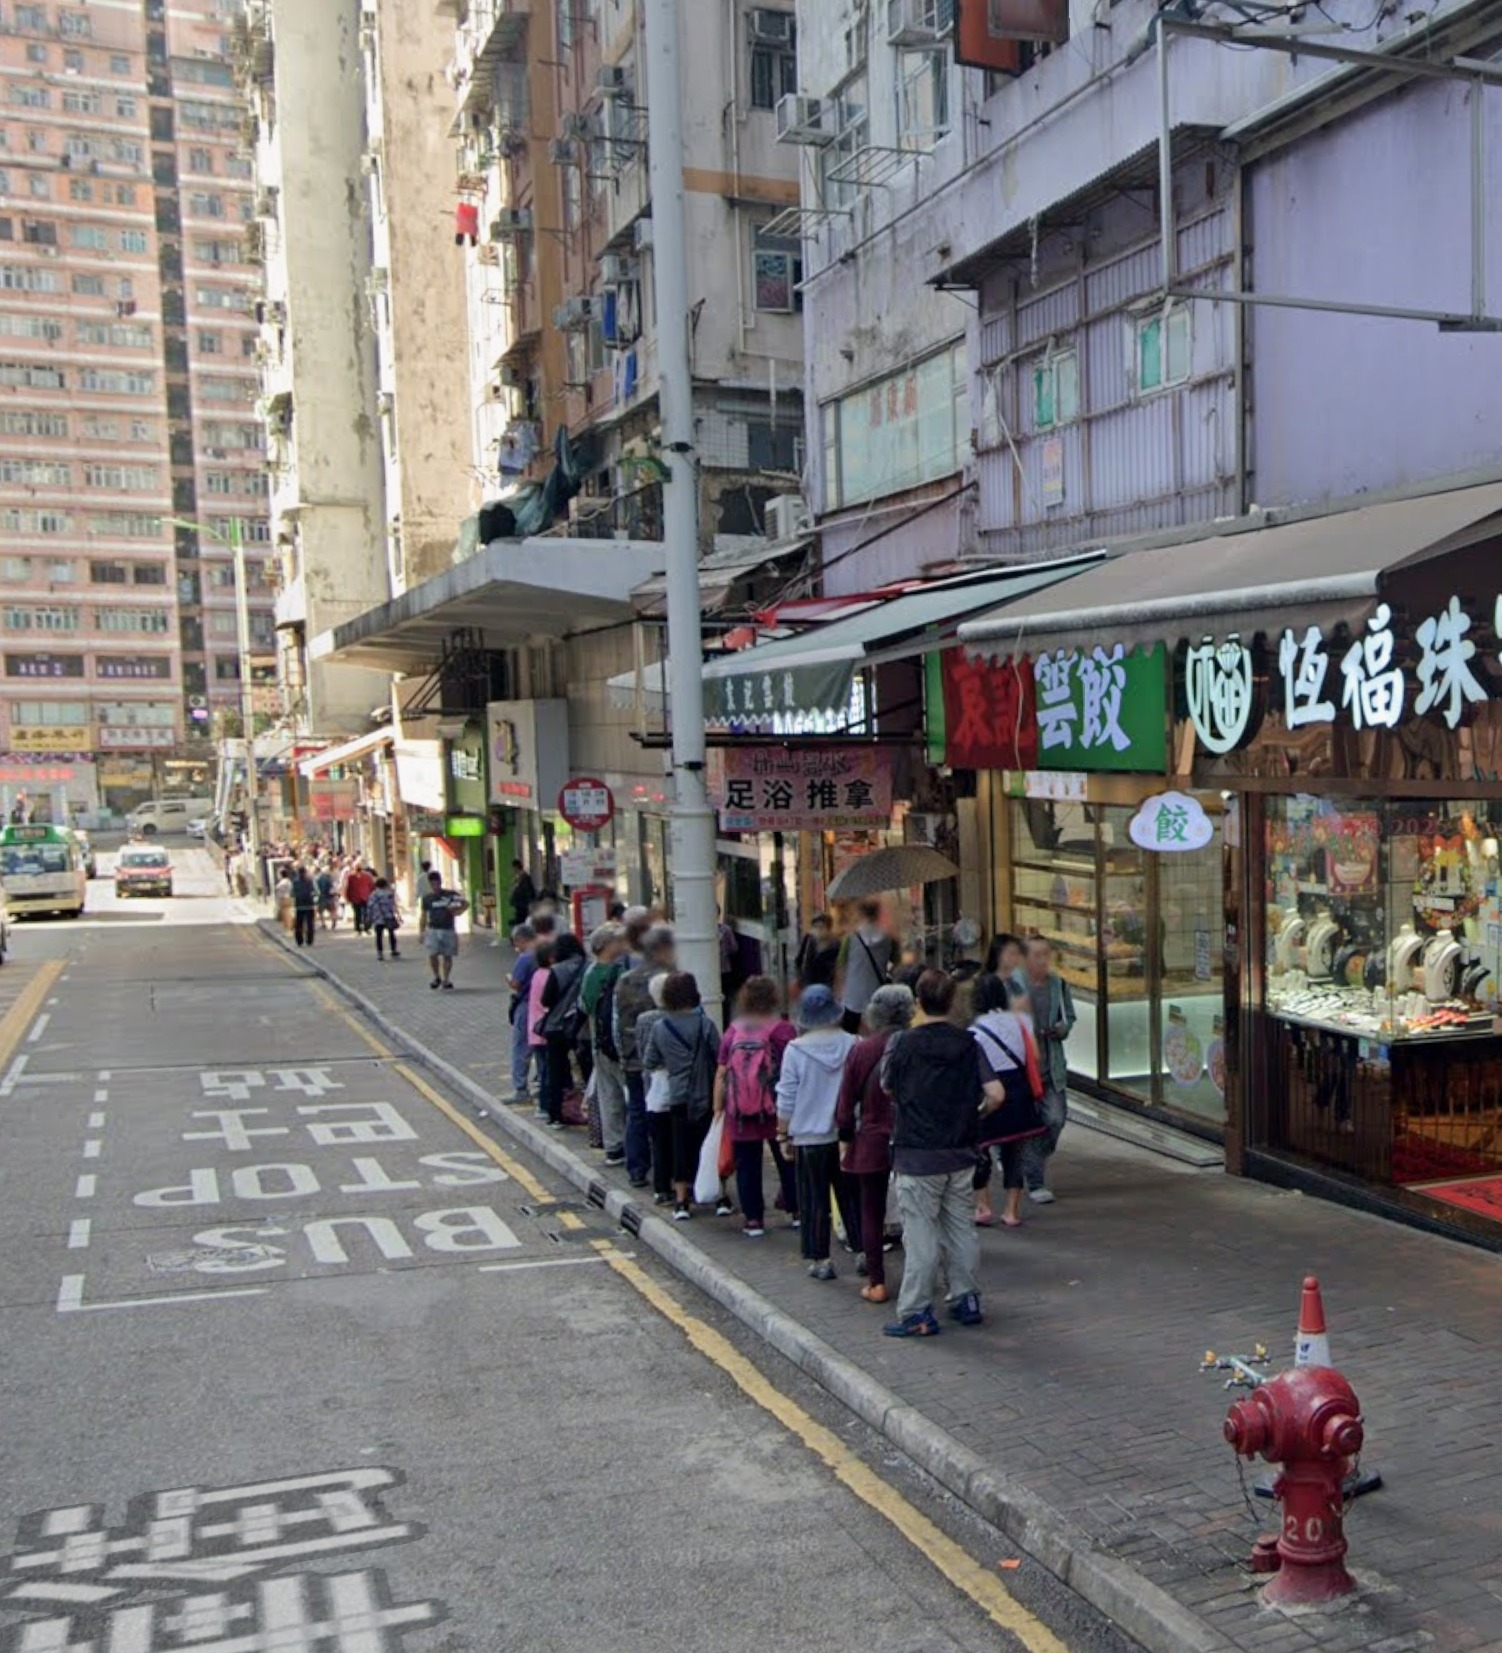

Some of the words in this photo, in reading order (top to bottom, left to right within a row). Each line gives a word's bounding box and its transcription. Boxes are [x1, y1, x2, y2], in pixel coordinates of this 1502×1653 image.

[725, 778, 873, 811] 足浴推拿
[1154, 802, 1189, 843] 餃
[200, 1066, 346, 1099] 站
[183, 1101, 418, 1150] 巴士
[134, 1152, 509, 1207] STOP
[194, 1206, 521, 1273] BUS
[1286, 1516, 1324, 1541] 20
